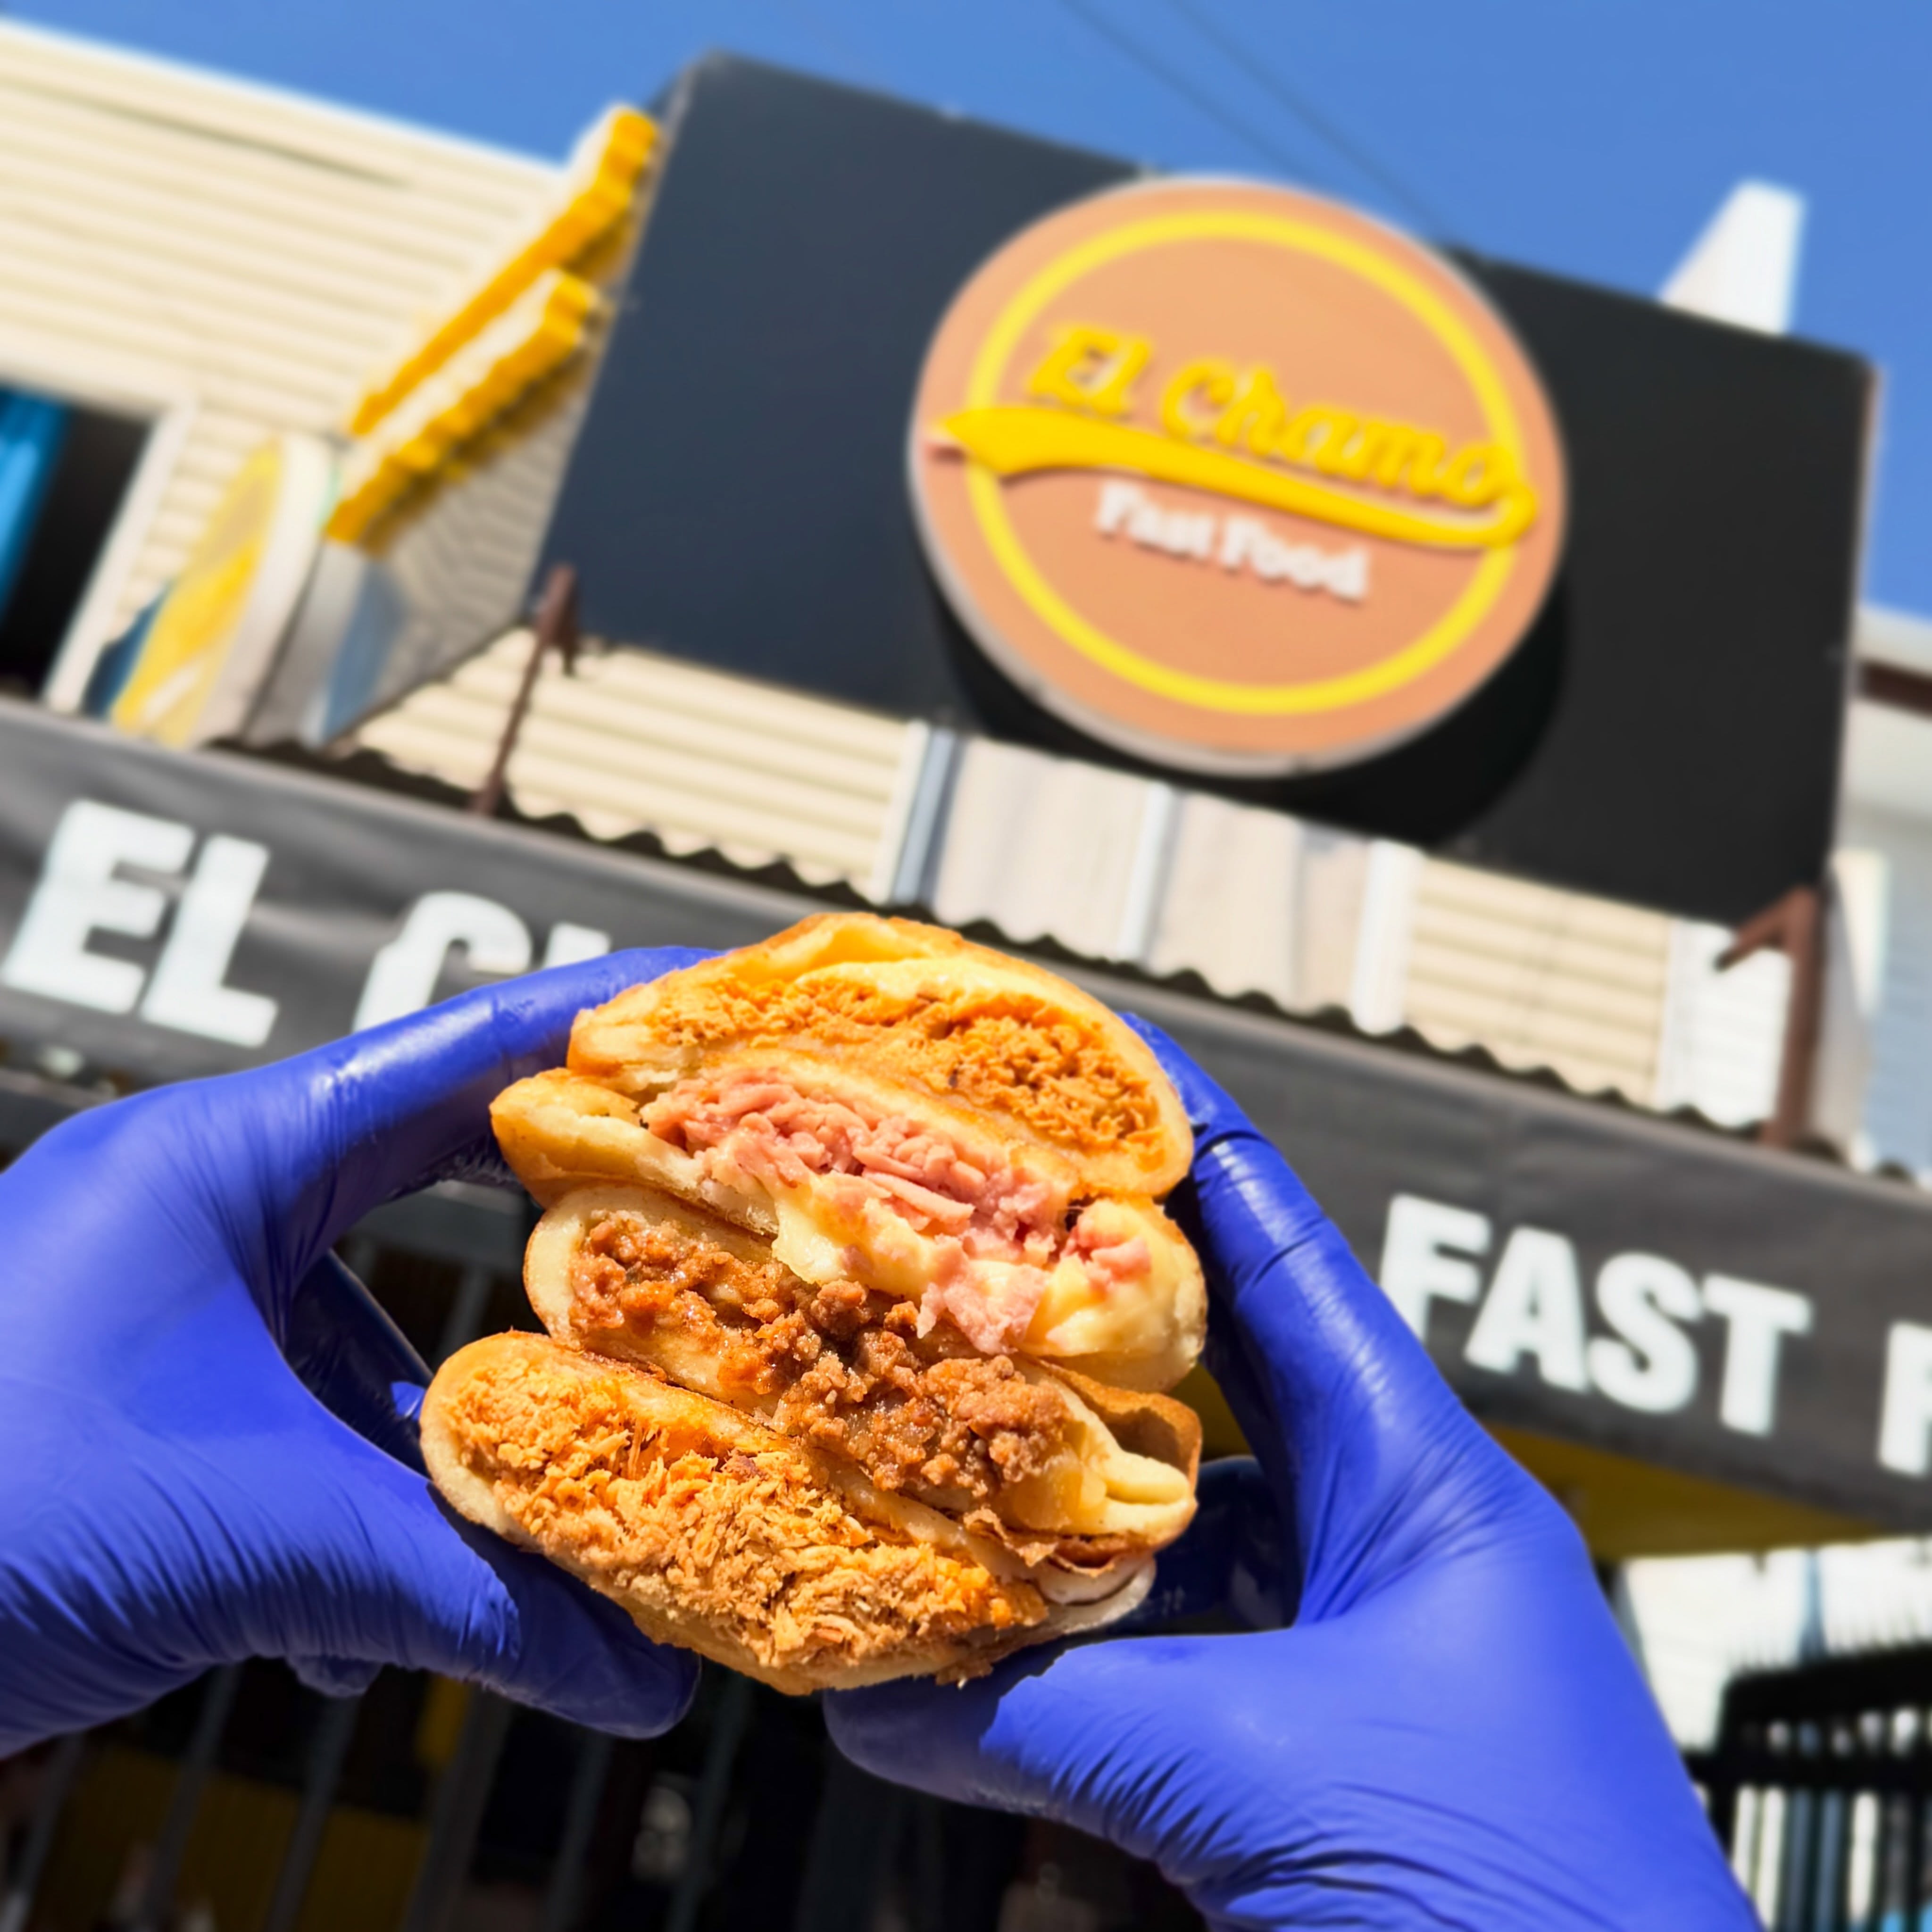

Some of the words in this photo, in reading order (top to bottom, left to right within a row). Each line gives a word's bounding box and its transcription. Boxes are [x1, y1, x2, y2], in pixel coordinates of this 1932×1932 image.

[1028, 324, 1154, 417] El
[1160, 358, 1520, 508] Chamo
[1092, 479, 1215, 558] Fast
[1218, 514, 1372, 604] Food
[2, 798, 278, 1047] EL
[1377, 1193, 1813, 1438] FAST
